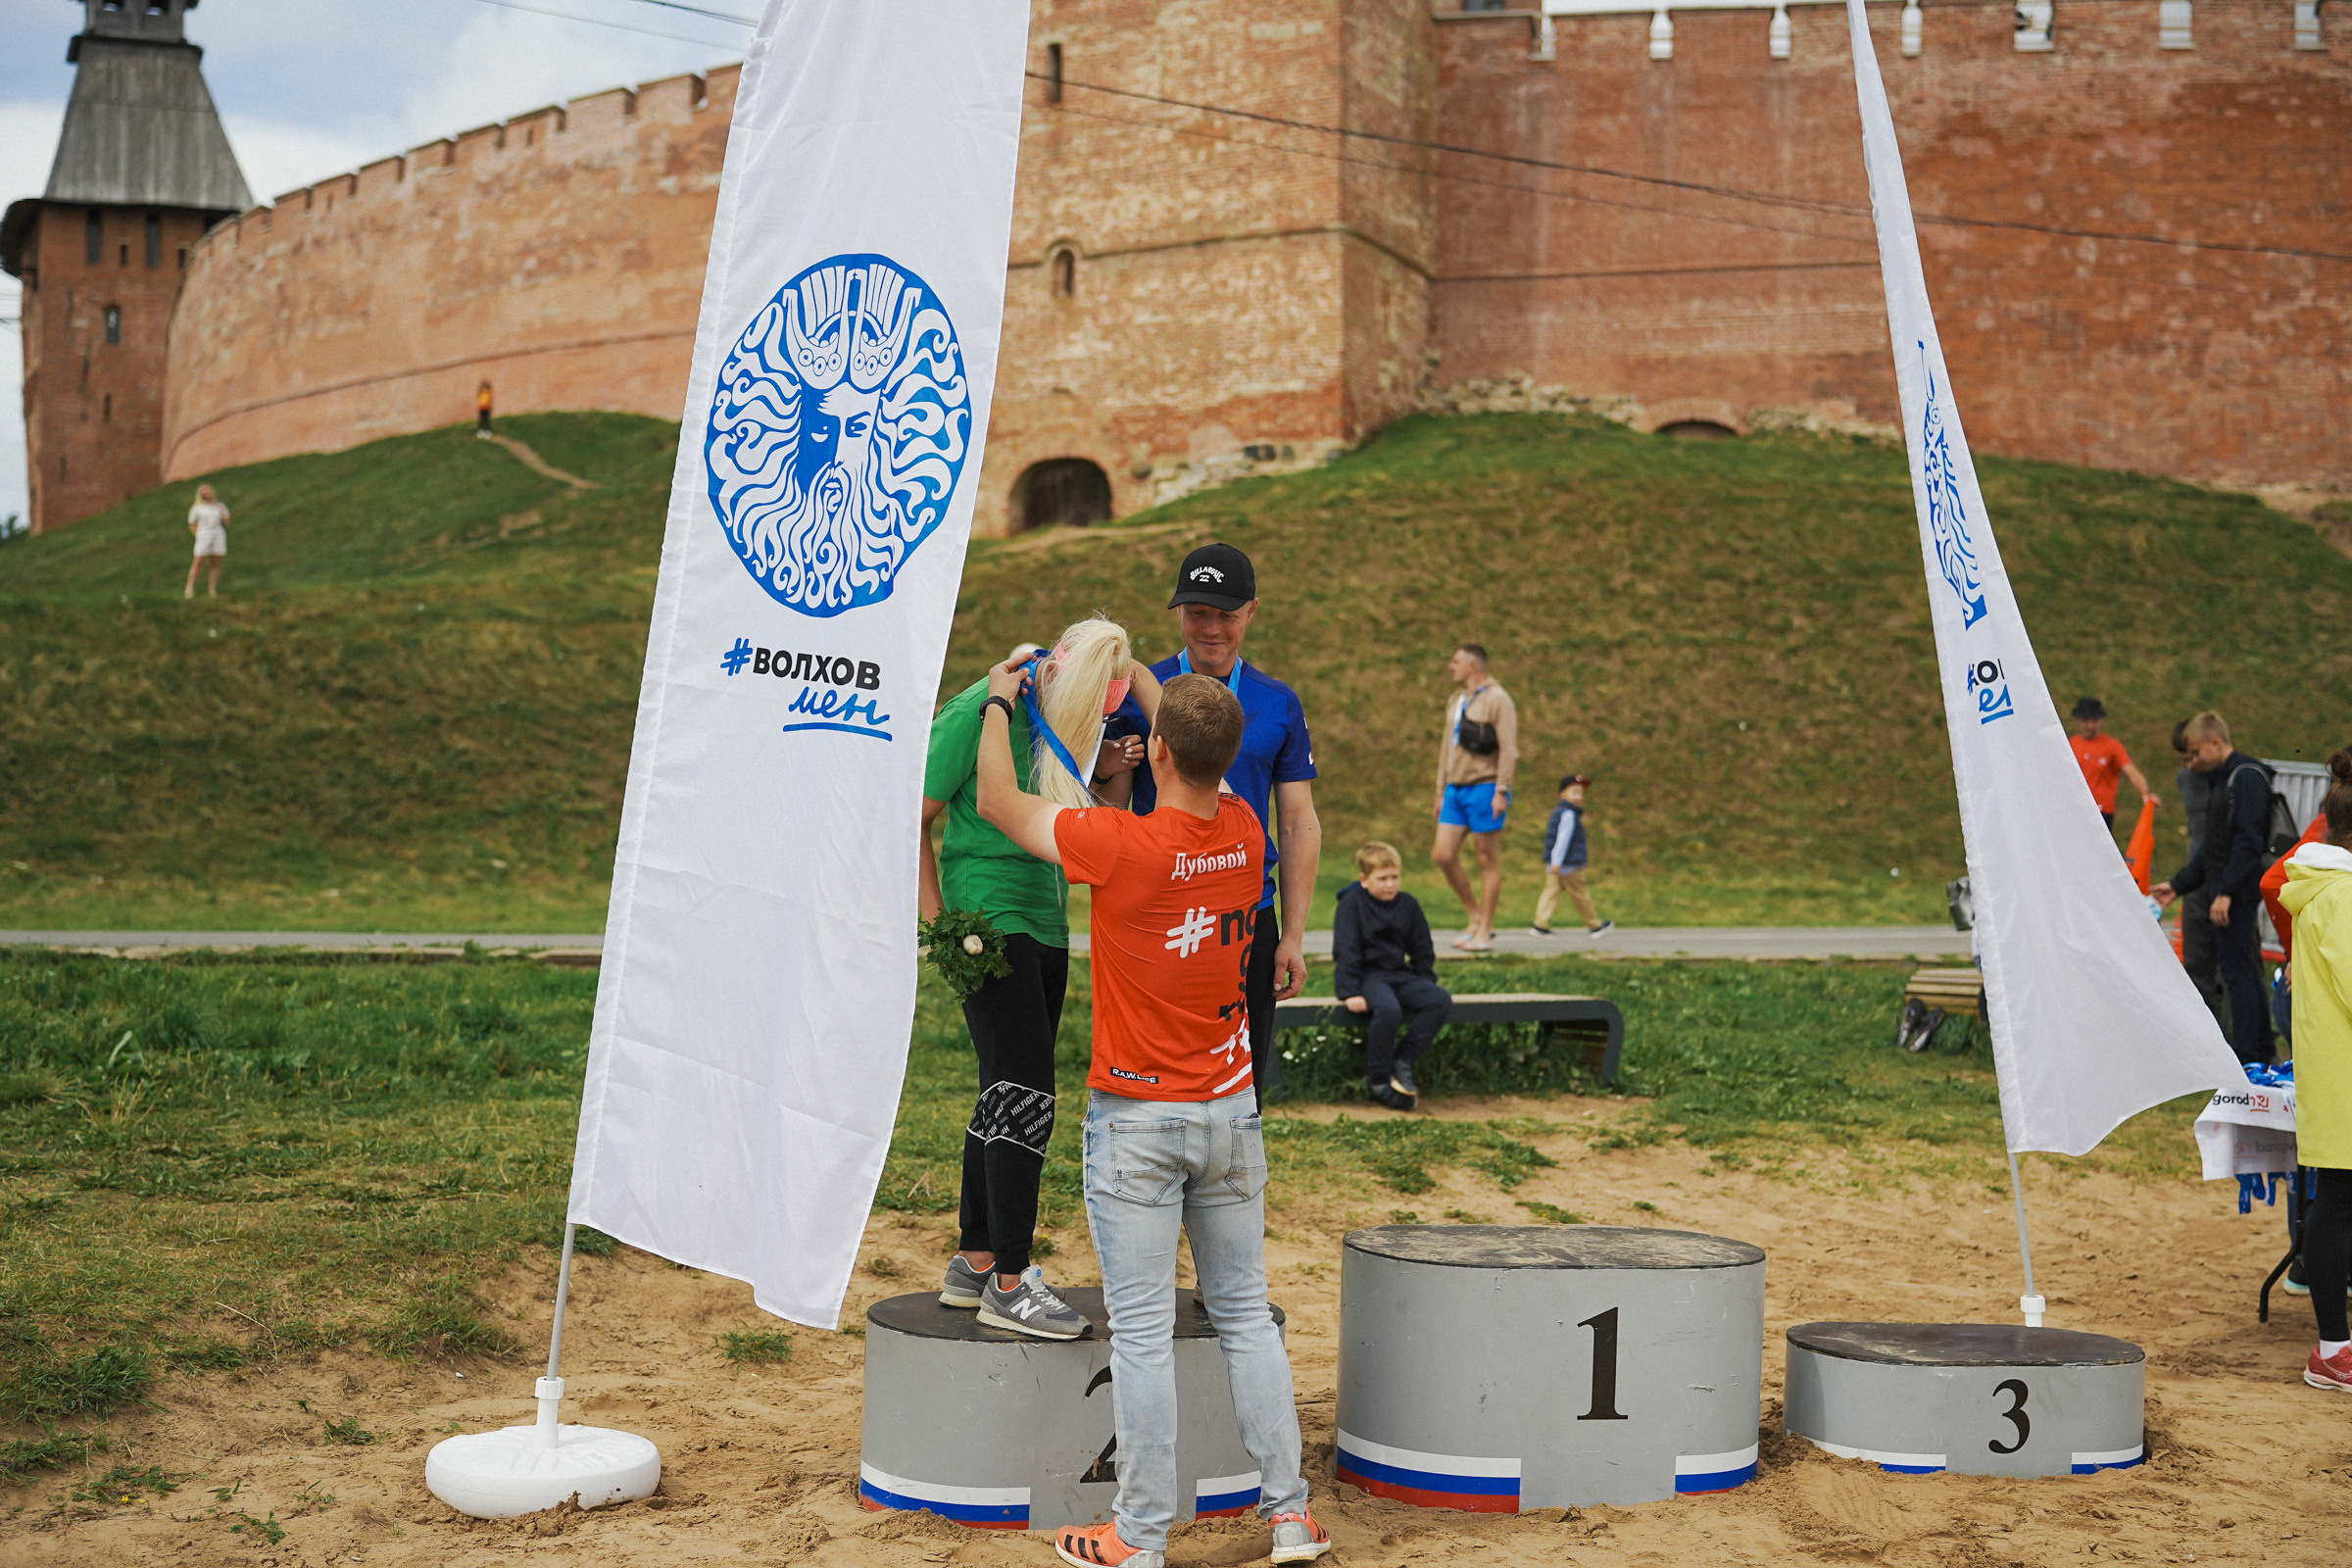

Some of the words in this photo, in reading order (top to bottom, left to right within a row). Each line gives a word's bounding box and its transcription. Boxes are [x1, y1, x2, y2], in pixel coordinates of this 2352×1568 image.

[1171, 843, 1247, 881] Дубовой
[1024, 1110, 1054, 1136] HILFIGER
[1577, 1306, 1629, 1420] 1
[1987, 1378, 2031, 1454] 3
